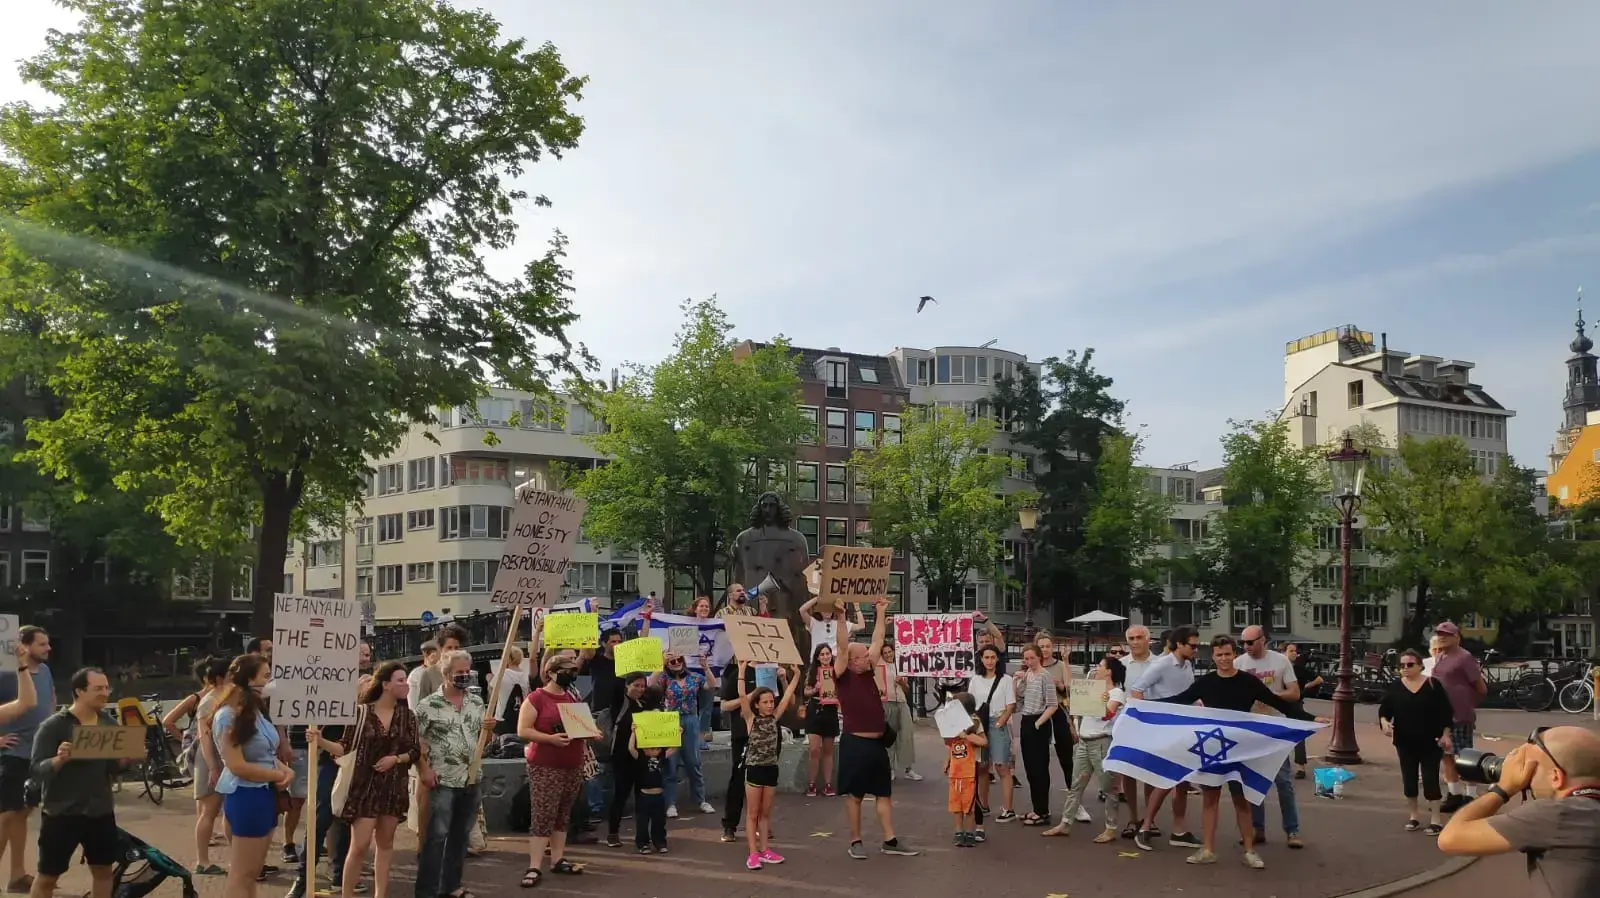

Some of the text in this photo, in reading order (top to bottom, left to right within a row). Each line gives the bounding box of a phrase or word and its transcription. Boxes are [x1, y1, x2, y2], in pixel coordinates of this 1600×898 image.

[538, 511, 559, 525] 0%
[513, 523, 572, 544] HONESTY
[527, 542, 550, 557] 0%
[499, 554, 571, 574] RESPONSIBILITY
[831, 551, 860, 570] SAVE
[275, 596, 354, 618] NETANYAHU
[490, 590, 547, 605] EGOISM
[275, 628, 357, 650] THE END
[895, 617, 973, 646] CRIME
[306, 655, 322, 665] OF
[898, 650, 975, 673] MINISTER
[274, 664, 356, 682] DEMOCRACY
[305, 685, 319, 695] IN
[75, 729, 127, 752] HOPE
